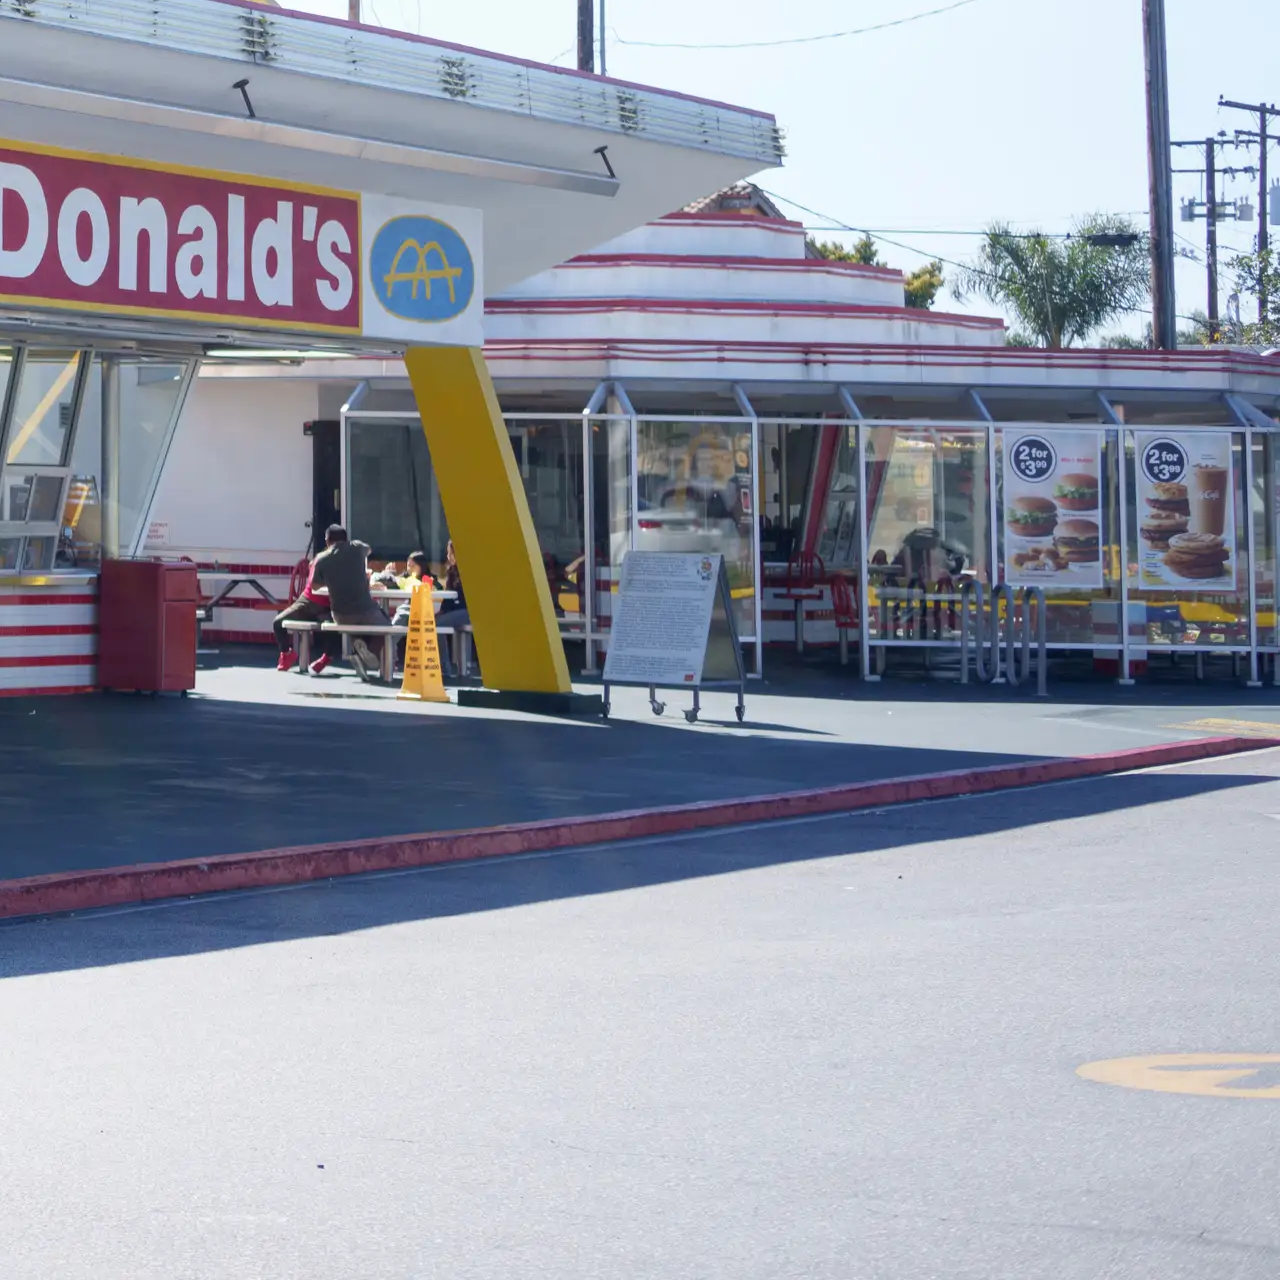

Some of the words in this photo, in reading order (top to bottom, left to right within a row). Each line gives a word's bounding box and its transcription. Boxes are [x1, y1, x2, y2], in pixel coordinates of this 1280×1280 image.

[1019, 445, 1030, 460] 2
[1031, 448, 1048, 458] for
[1149, 449, 1160, 464] 2
[1161, 451, 1179, 462] for
